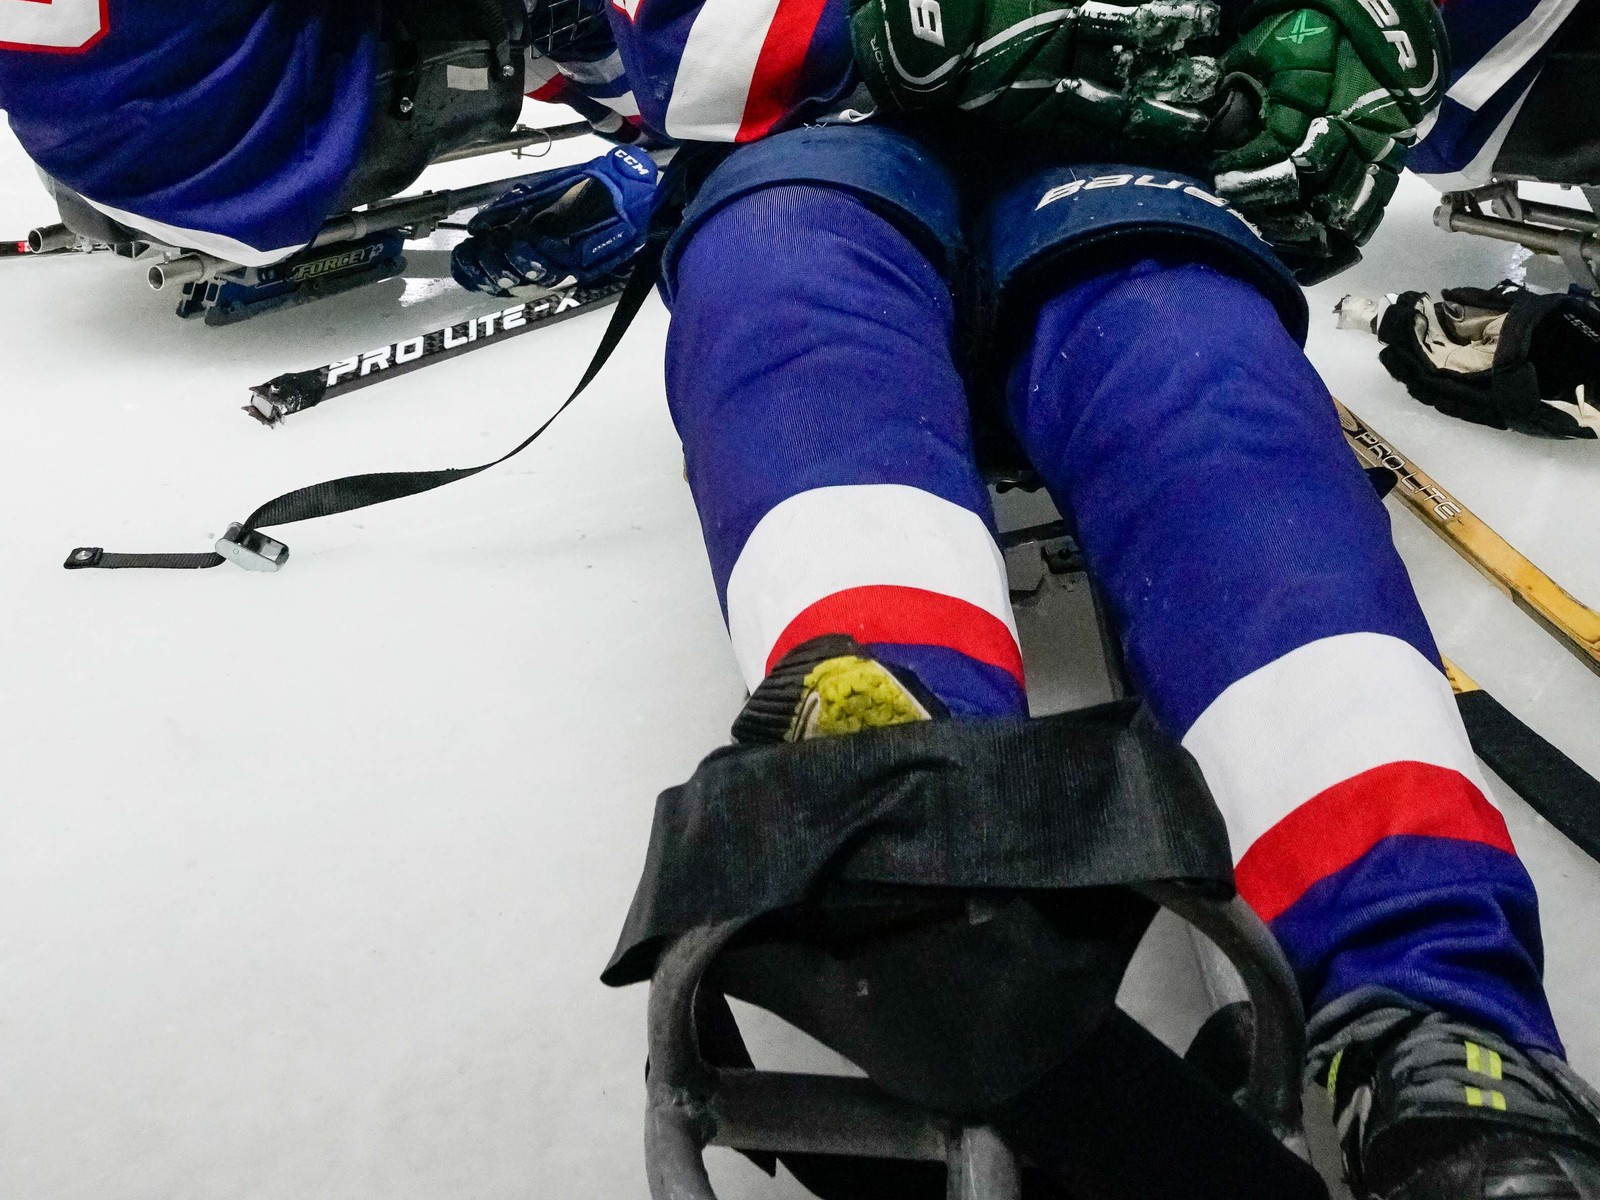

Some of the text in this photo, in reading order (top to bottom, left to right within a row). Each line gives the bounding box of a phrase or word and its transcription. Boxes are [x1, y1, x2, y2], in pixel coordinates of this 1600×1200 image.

[614, 149, 650, 175] CCM
[326, 286, 581, 388] PRO LITE-X
[1354, 431, 1462, 521] PRO LITE
